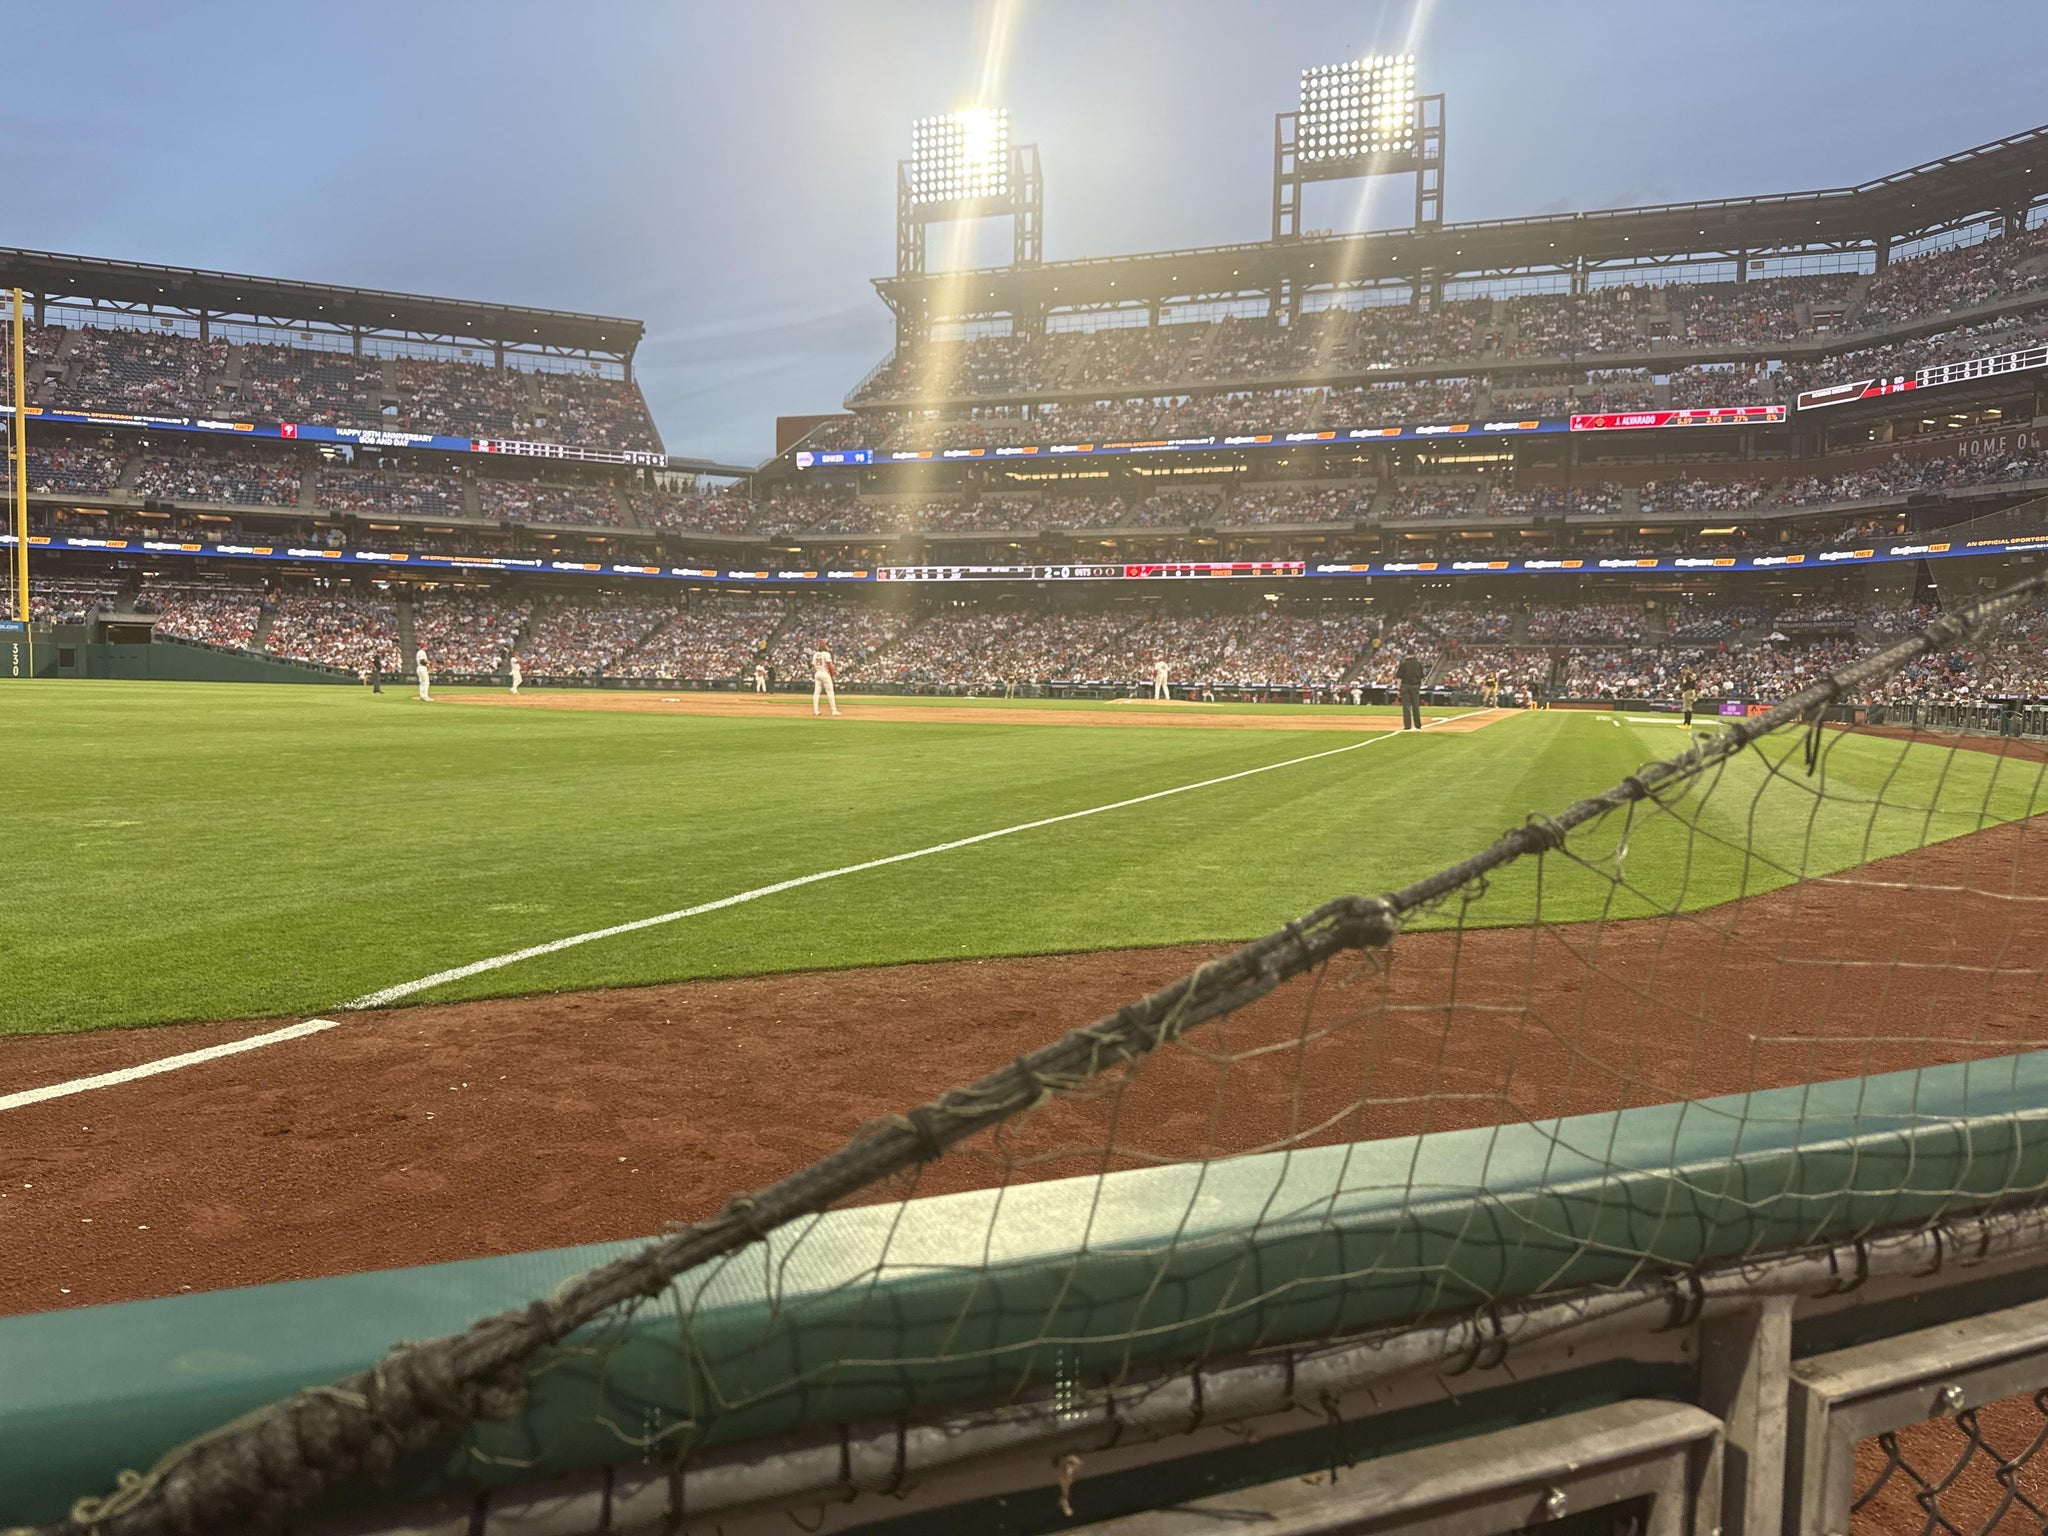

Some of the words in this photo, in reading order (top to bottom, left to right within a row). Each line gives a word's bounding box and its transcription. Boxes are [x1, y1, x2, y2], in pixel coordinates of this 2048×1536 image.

[1622, 416, 1656, 425] ALVARADO
[336, 428, 361, 437] HAPPY
[1958, 436, 2007, 457] HOME
[1978, 538, 2010, 546] OFFICIAL
